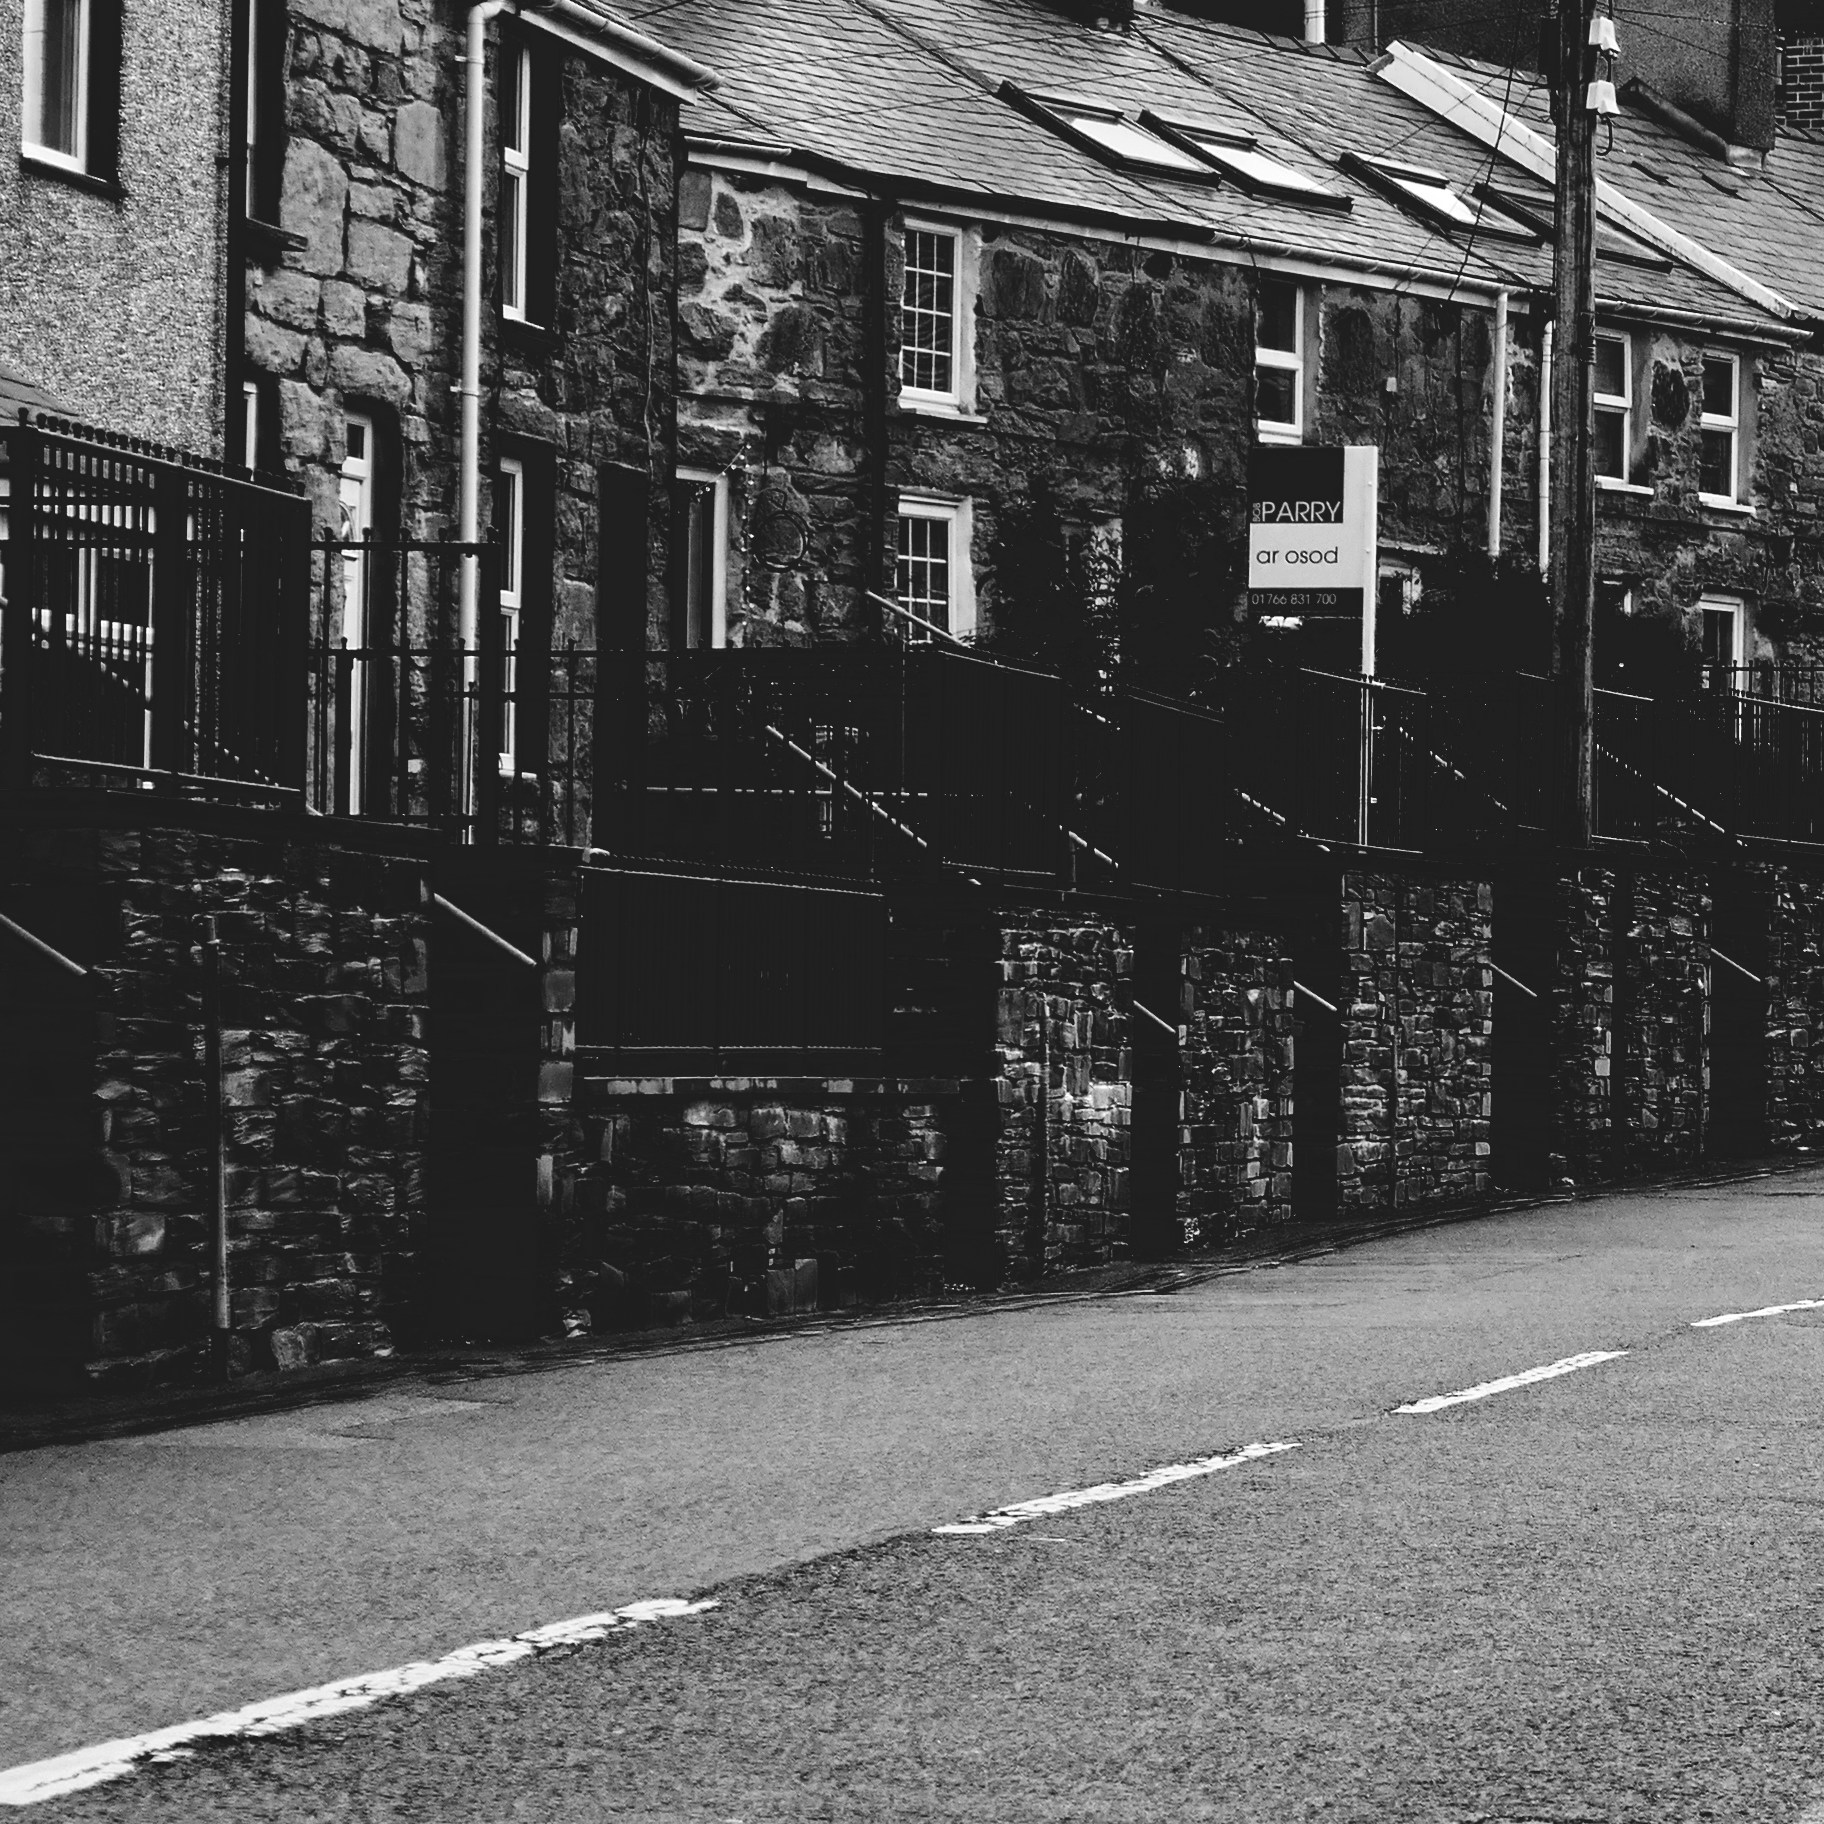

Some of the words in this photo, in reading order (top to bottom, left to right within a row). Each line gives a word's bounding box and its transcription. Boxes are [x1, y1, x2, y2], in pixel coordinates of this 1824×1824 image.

[1262, 501, 1341, 522] PARRY
[1257, 550, 1279, 564] ar
[1285, 546, 1338, 564] osod
[1251, 593, 1288, 605] 01766
[1290, 593, 1310, 605] 831
[1316, 593, 1337, 605] 700
